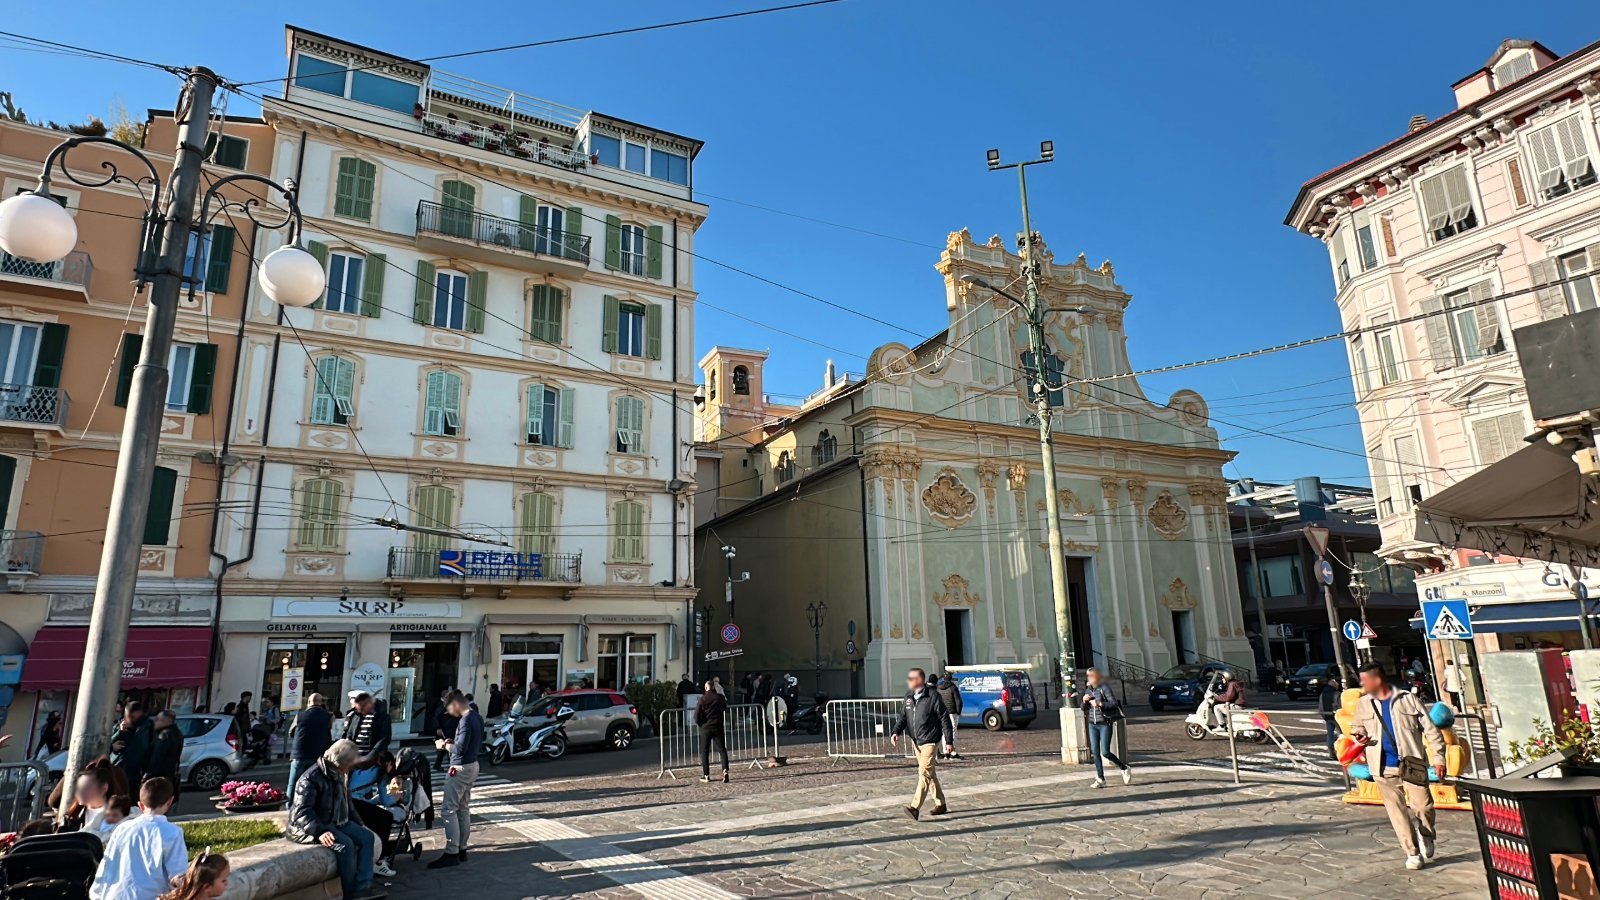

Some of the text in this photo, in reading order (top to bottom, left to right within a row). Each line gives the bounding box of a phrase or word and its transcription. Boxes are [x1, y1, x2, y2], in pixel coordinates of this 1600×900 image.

[472, 551, 542, 566] REALE
[1471, 588, 1502, 596] Manzoni
[266, 623, 317, 631] GELATERIA
[389, 623, 447, 631] ARTIGIANALE
